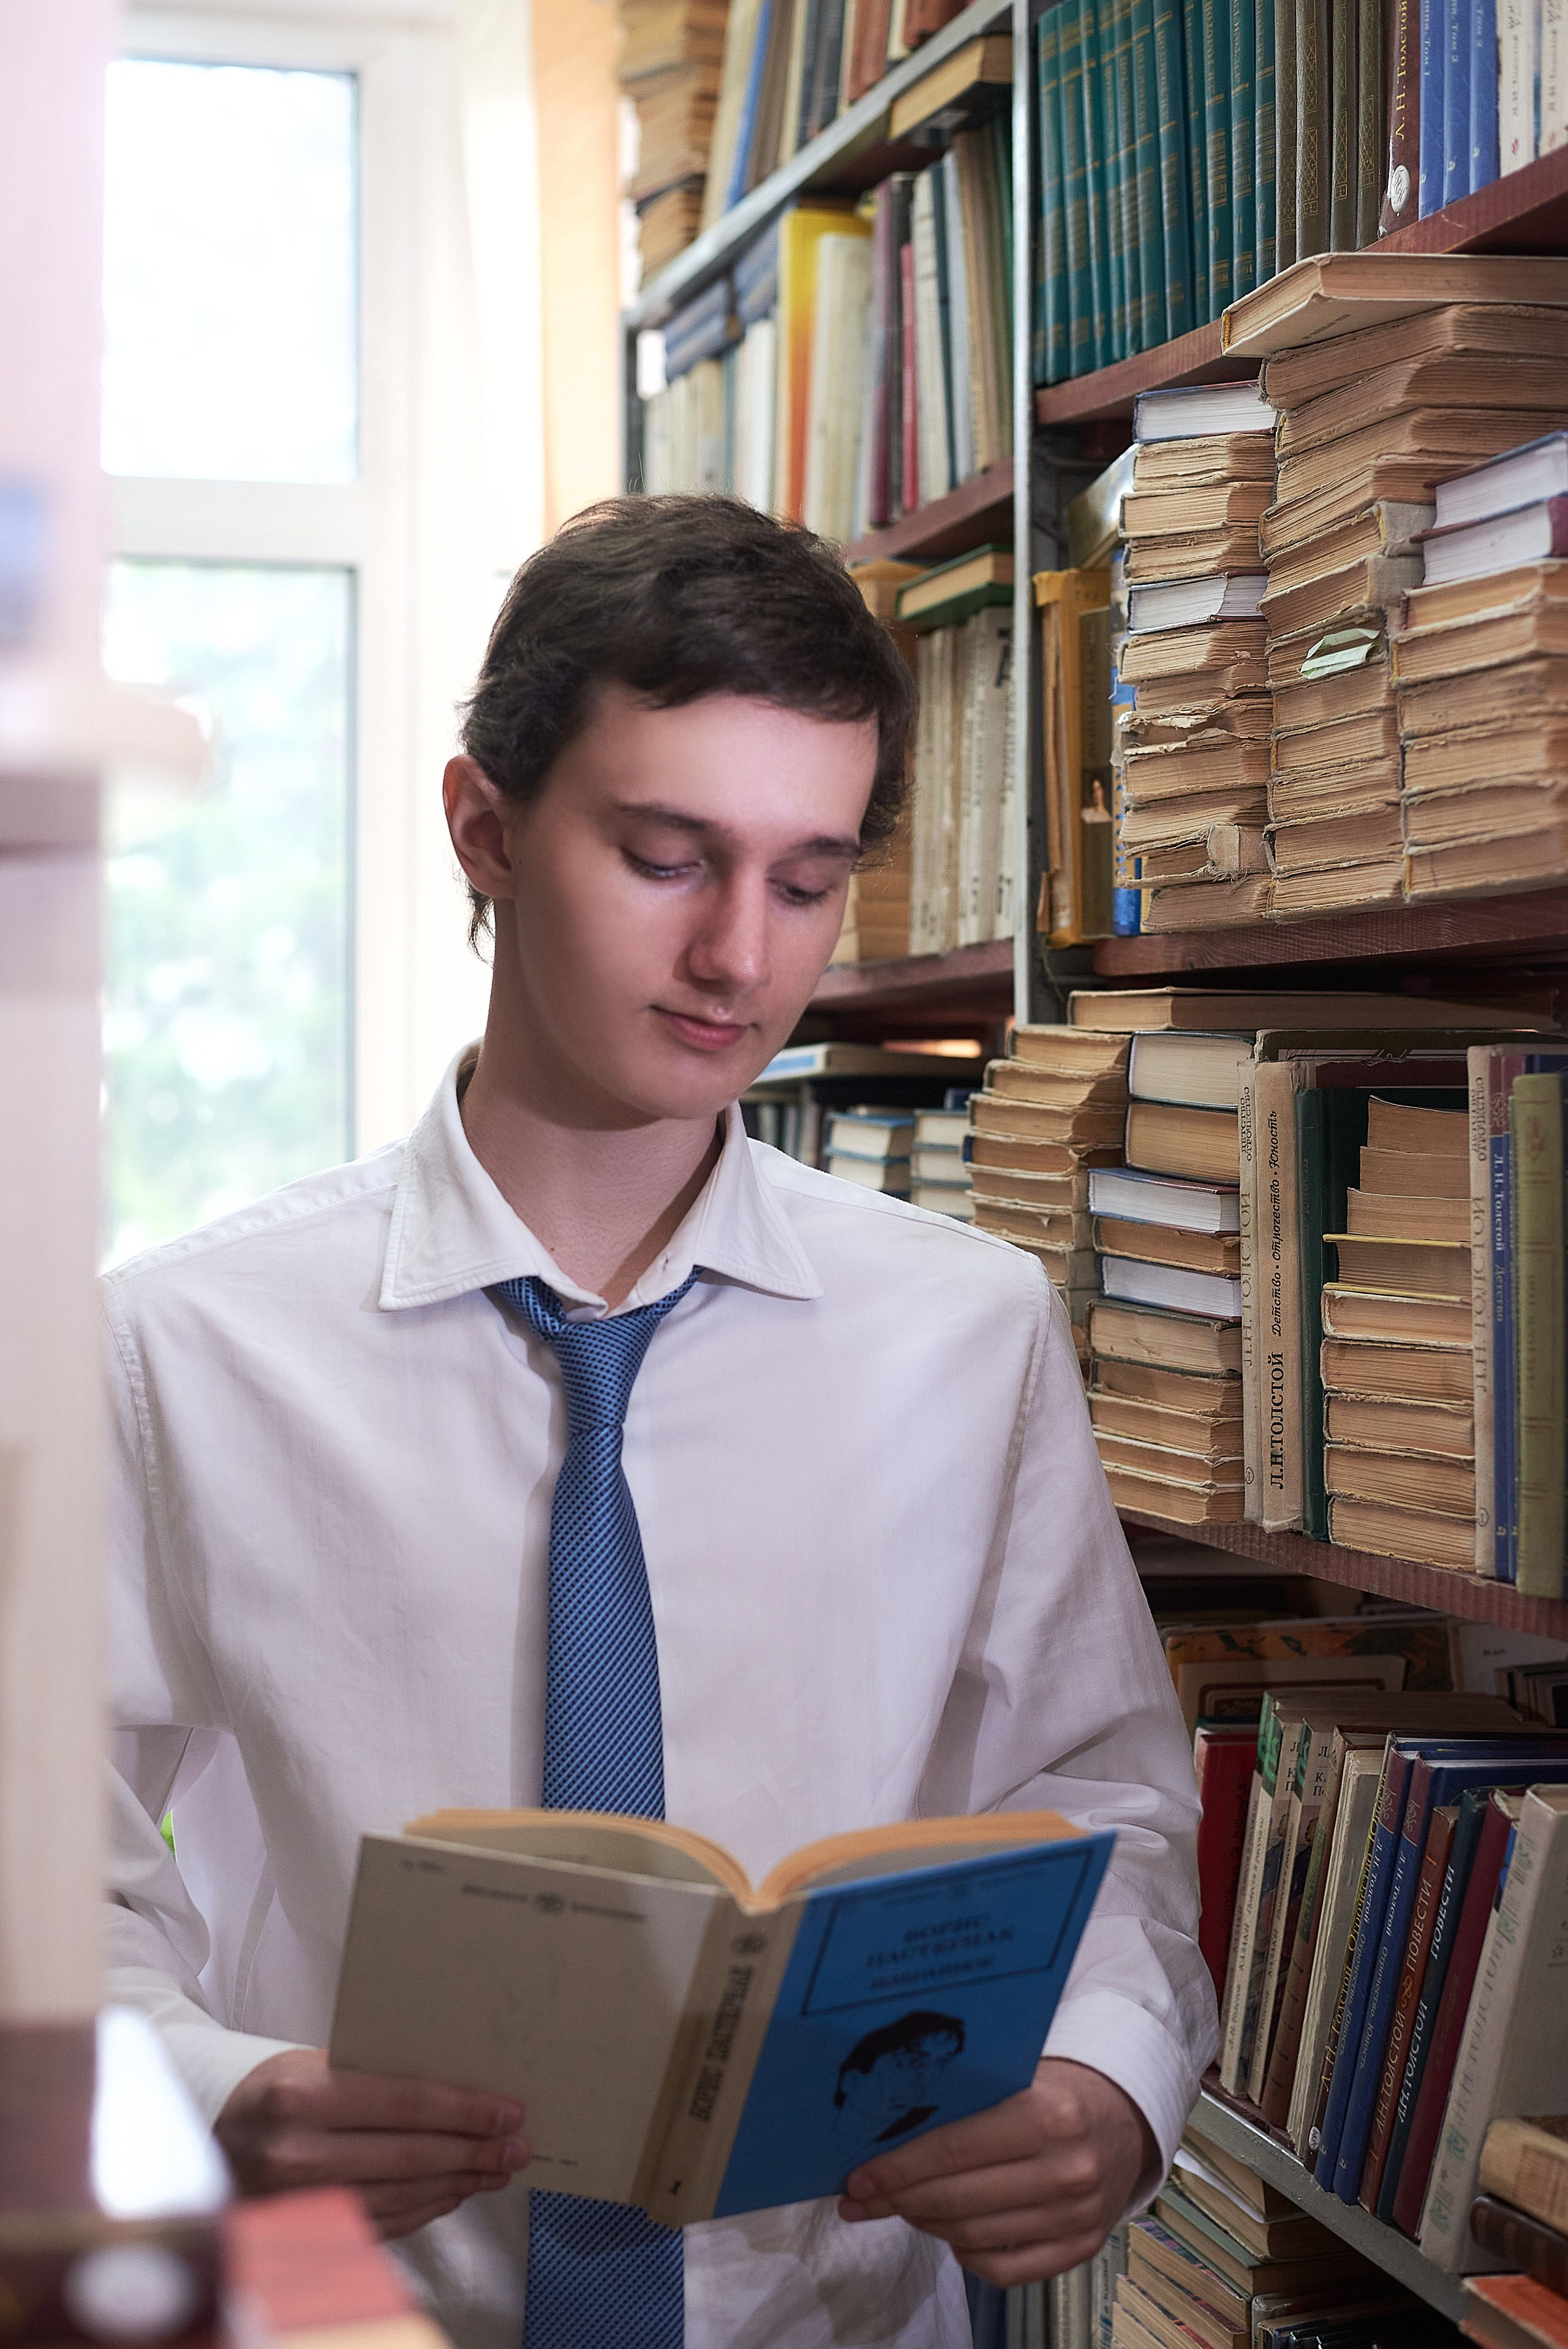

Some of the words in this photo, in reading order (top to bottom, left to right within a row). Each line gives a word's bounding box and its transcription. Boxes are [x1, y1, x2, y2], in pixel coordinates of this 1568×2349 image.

[1268, 1110, 1280, 1169] Юность
[1270, 1179, 1284, 1262] Отрочество
[1494, 1191, 1505, 1252] Толстой
[1272, 1272, 1283, 1337] Детство
[1363, 1872, 1378, 1923] Толстой
[1385, 1884, 1401, 1936] Толстой
[1381, 2010, 1406, 2097] ТОЛСТОЙ
[1406, 1877, 1432, 1972] ПОВЕСТИ
[1403, 1999, 1428, 2088] ТОЛСТОЙ
[1430, 1864, 1456, 1960] ПОВЕСТИ
[1360, 2023, 1374, 2069] Юность
